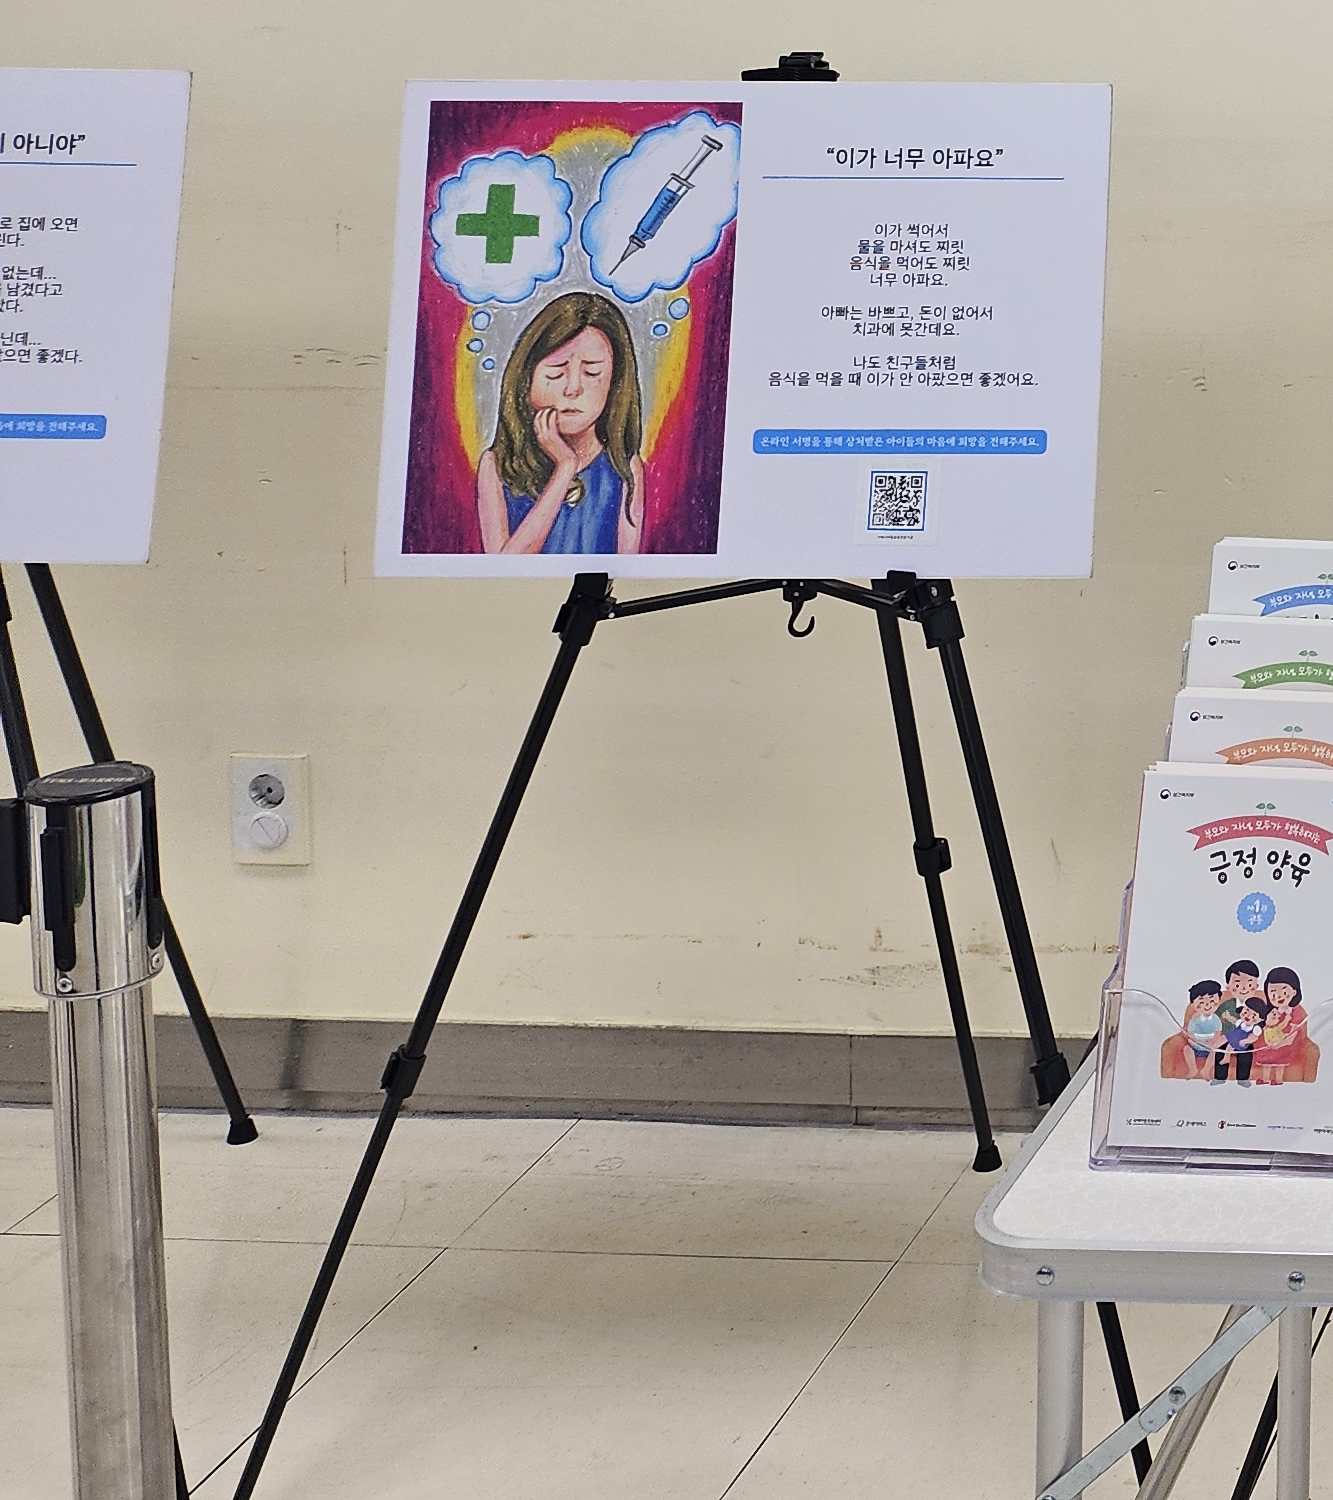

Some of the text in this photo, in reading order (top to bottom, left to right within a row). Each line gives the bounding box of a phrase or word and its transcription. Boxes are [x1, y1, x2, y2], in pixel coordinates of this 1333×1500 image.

[12, 132, 86, 156] 아니야”
[826, 147, 1004, 170] “이가 너무 아파요”
[17, 216, 46, 232] 집에
[49, 217, 79, 232] 오면
[874, 223, 949, 239] 이가 썩어서
[857, 239, 964, 255] 물을 마셔도 찌릿
[849, 255, 970, 271] 음식을 먹어도 찌릿
[870, 272, 948, 288] 너무 아파요.
[7, 282, 63, 297] 남겼다고
[821, 305, 993, 322] 아빠는 바쁘고, 돈이 없어서
[852, 321, 960, 338] 치과에 못간데요.
[35, 348, 83, 364] 좋겠다.
[853, 355, 956, 371] 나도 친구들처럼
[768, 371, 1039, 388] 음식을 먹을 때 이가 안 아팠으면 좋겠어요.
[1209, 846, 1312, 888] 긍정 양육
